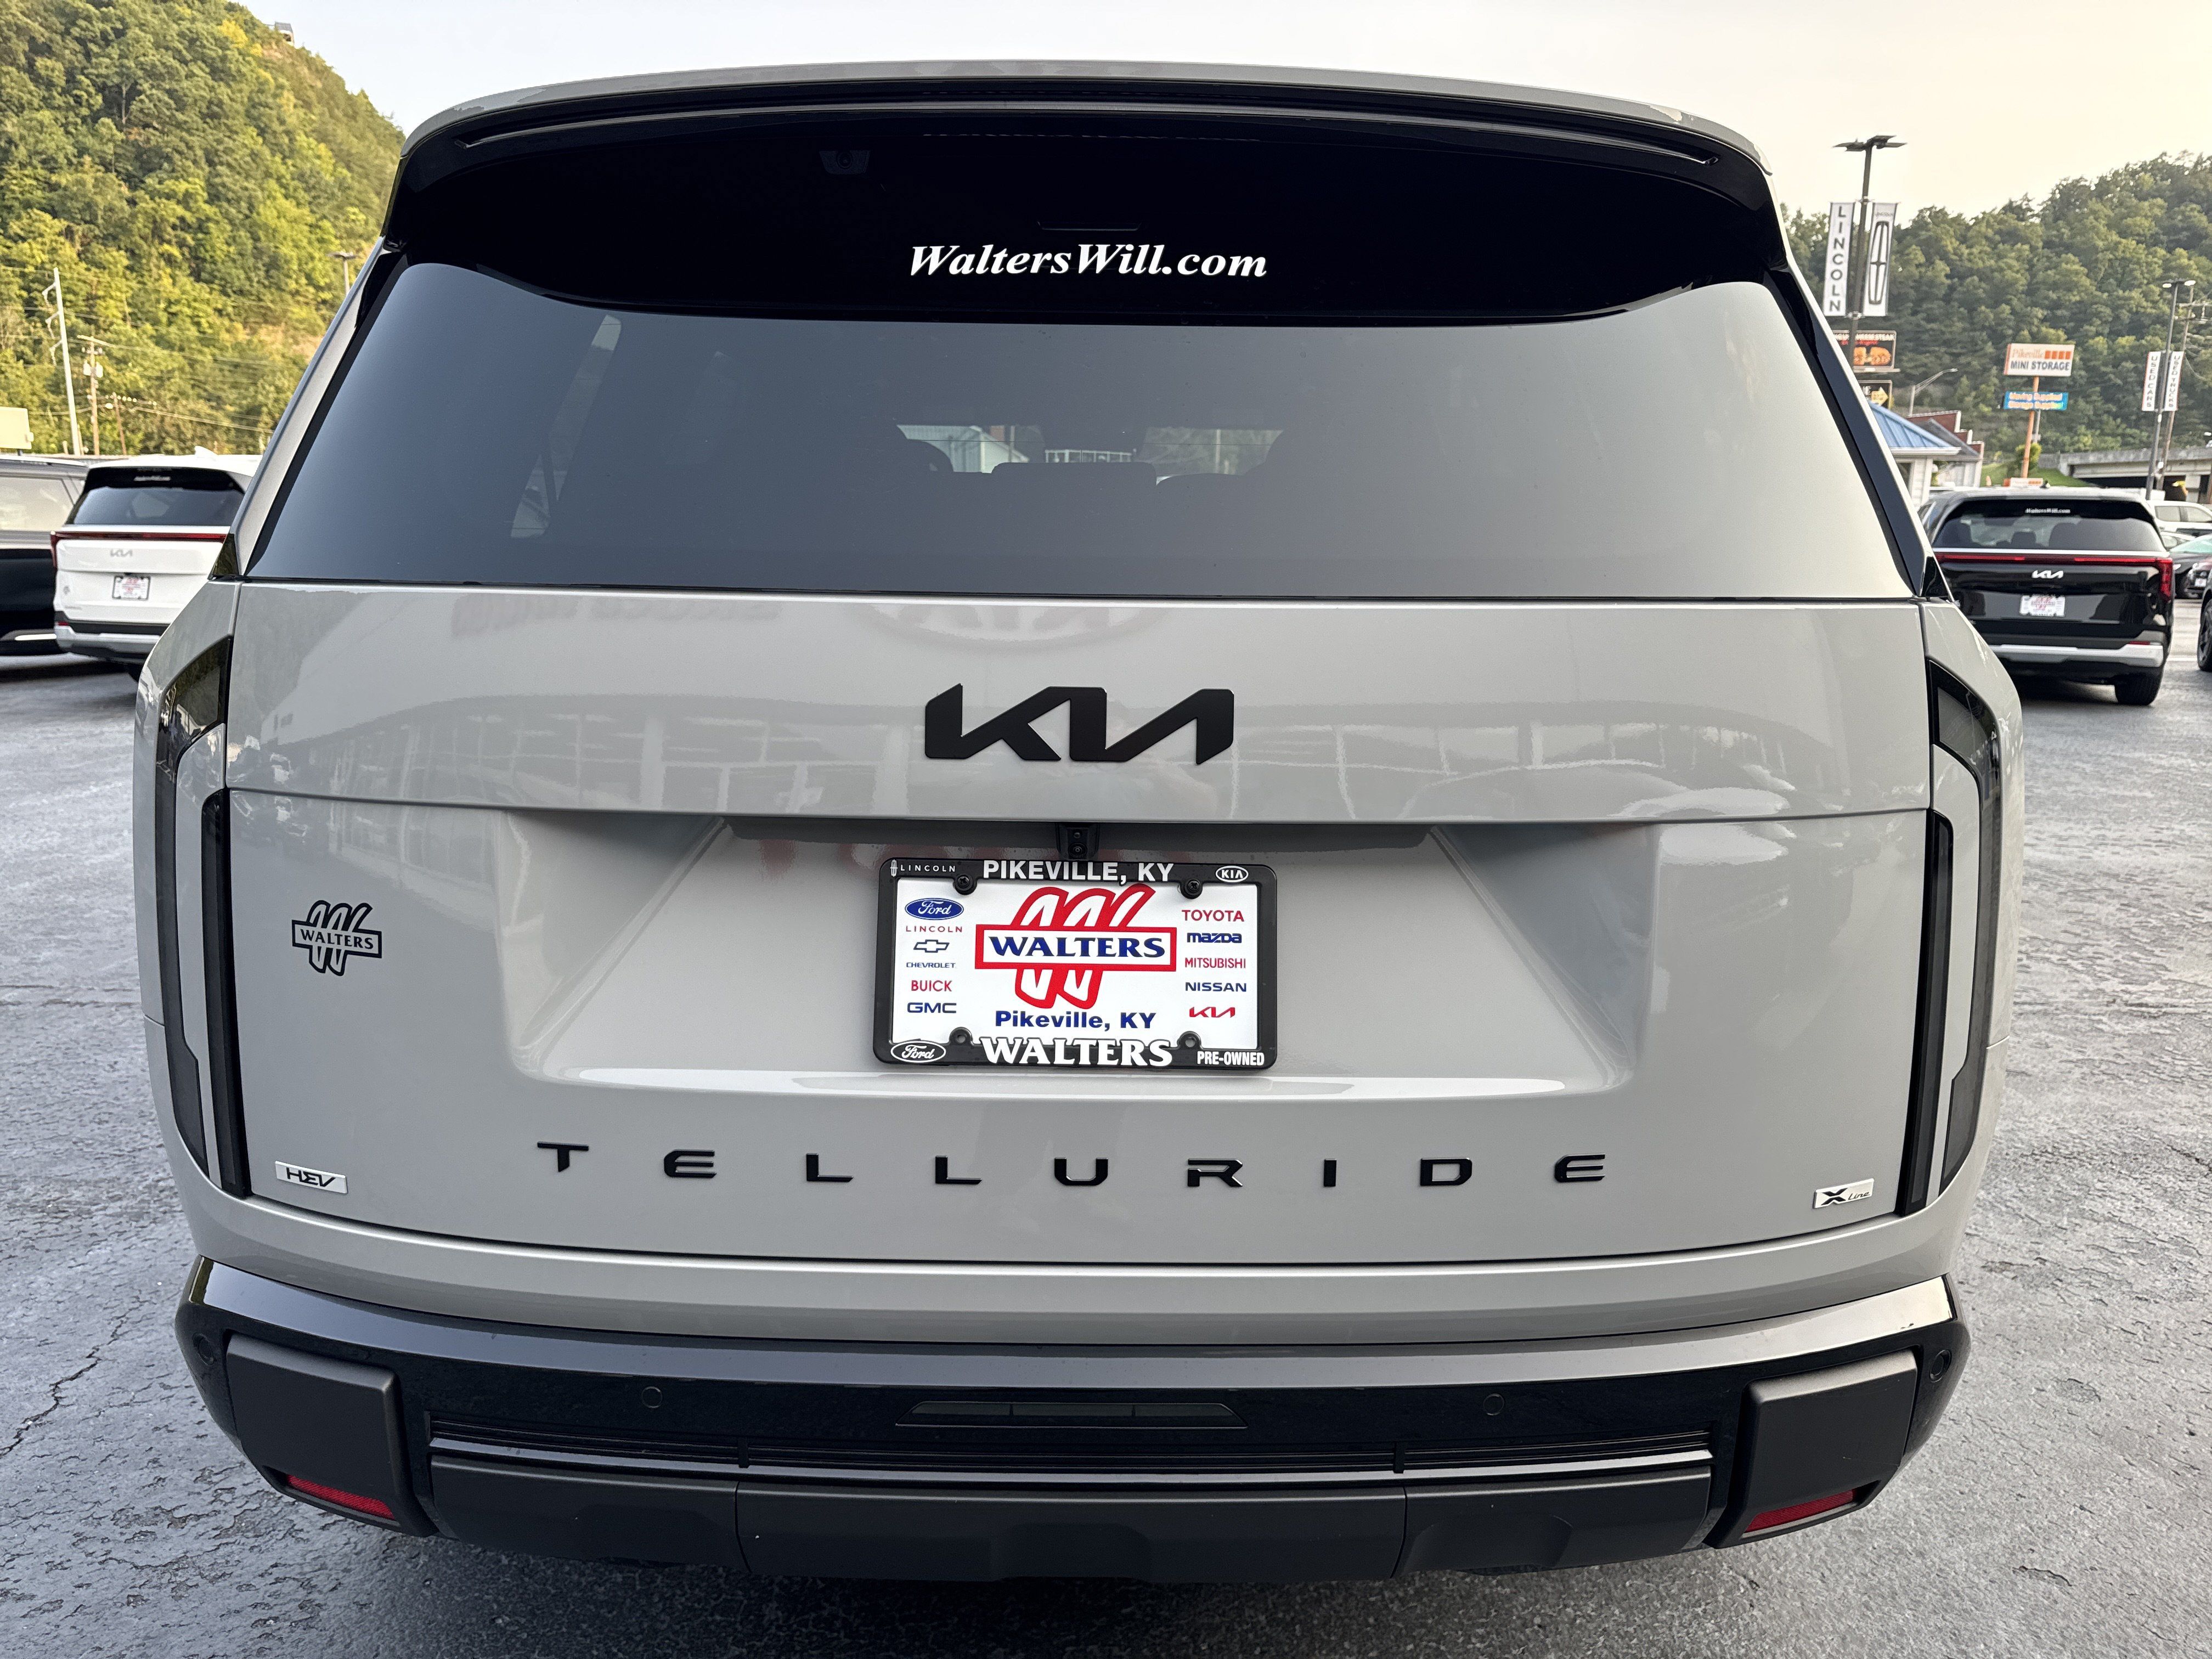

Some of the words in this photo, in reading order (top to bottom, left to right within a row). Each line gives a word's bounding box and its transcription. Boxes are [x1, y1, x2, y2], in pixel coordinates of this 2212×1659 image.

[910, 244, 1268, 278] WaltersWill.com
[1829, 205, 1846, 312] LINCOLN
[2010, 360, 2029, 370] MINI
[2031, 360, 2070, 371] STORAGE
[2148, 355, 2158, 381] USED
[2032, 570, 2064, 579] KIA
[924, 682, 1234, 765] KIA
[900, 864, 956, 873] LINCOLN
[983, 860, 1127, 885] PIKEVILLE,
[1137, 862, 1174, 882] KY
[1221, 869, 1243, 879] KIA
[918, 900, 952, 915] Ford
[1181, 909, 1245, 922] TOYOTA
[300, 928, 374, 950] WALTERS
[988, 936, 1166, 958] WALTERS
[1184, 957, 1246, 969] MITSUBISHI
[911, 980, 952, 992] BUICK
[1185, 981, 1247, 992] NISSAN
[907, 1002, 957, 1014] GMC
[1189, 1006, 1236, 1018] KIA
[995, 1010, 1110, 1032] Pikeville,
[1120, 1012, 1156, 1029] KY
[901, 1043, 935, 1059] Ford
[979, 1036, 1173, 1066] WALTERS
[1196, 1051, 1265, 1066] PRE-OWNED
[537, 1141, 1606, 1188] TELLURIDE
[286, 1166, 336, 1187] HEV
[1820, 1187, 1849, 1206] X
[1848, 1191, 1871, 1201] Line
